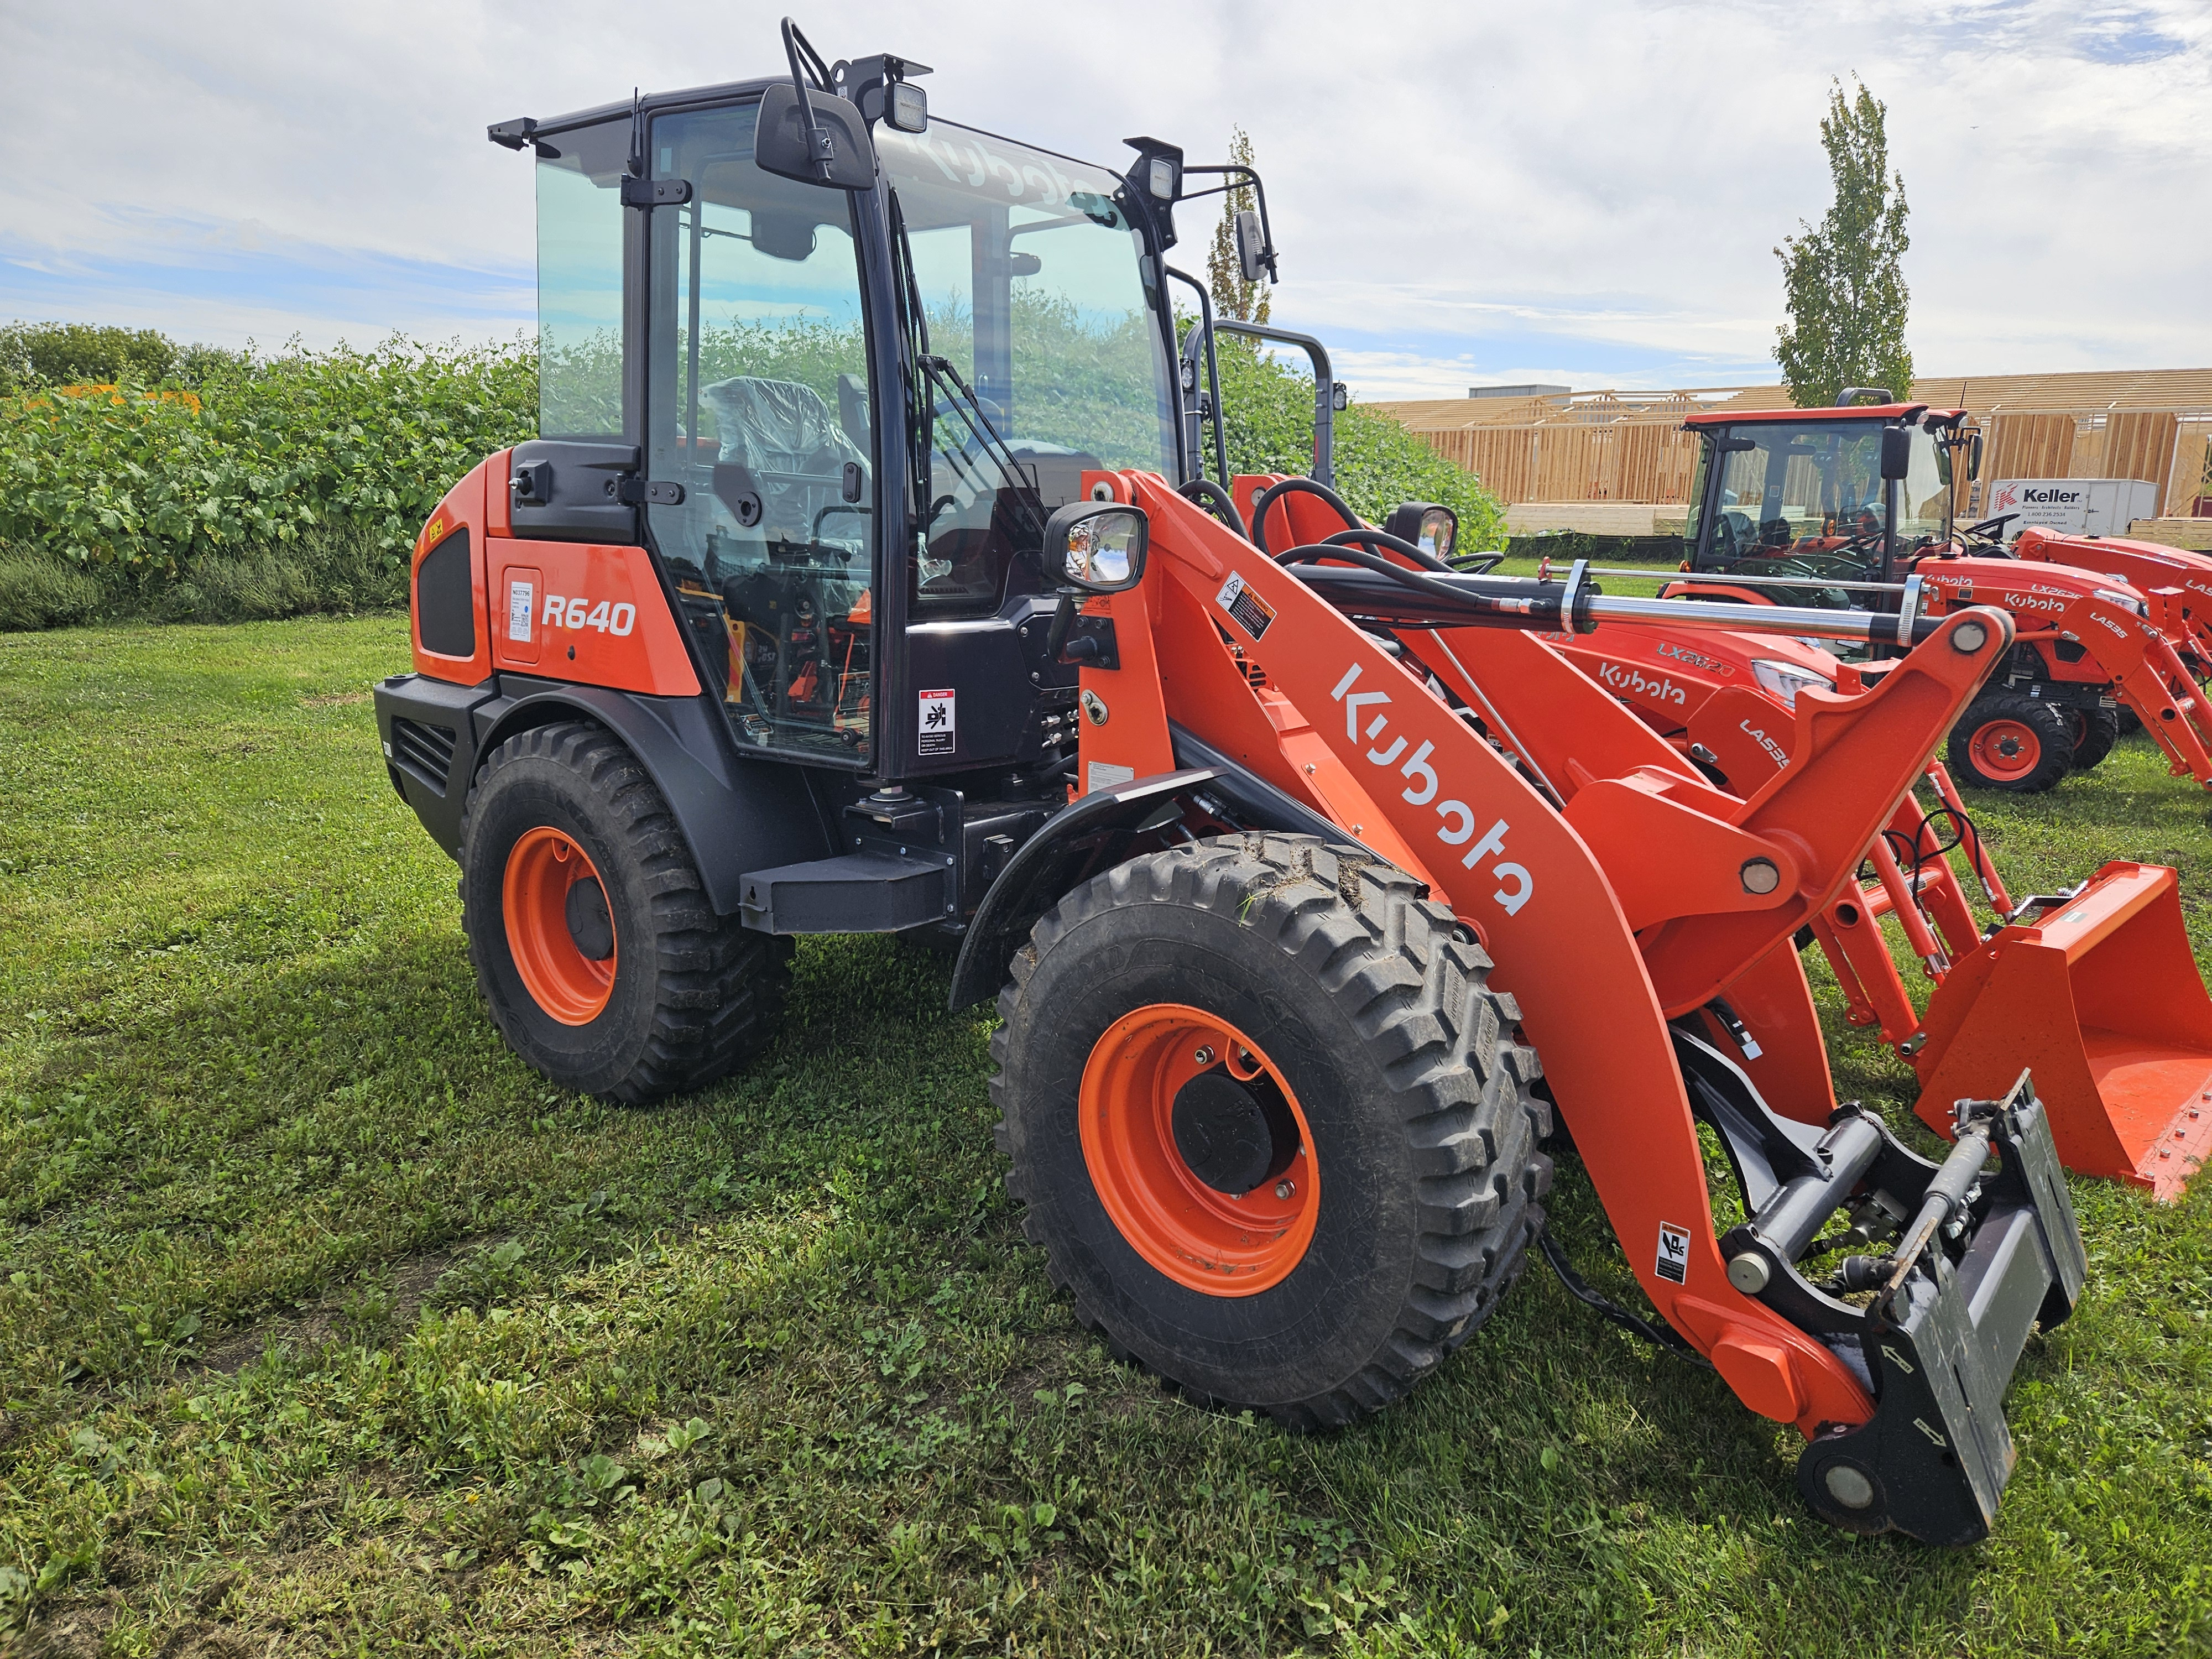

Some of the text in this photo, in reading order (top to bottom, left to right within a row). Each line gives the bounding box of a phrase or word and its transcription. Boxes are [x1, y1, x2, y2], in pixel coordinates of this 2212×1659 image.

[902, 127, 1112, 221] Kubota
[2023, 489, 2079, 503] Keller
[541, 594, 636, 636] R640
[2005, 593, 2064, 612] Kubota
[2090, 612, 2128, 639] LA535
[1657, 643, 1735, 678] LX2620
[1599, 662, 1686, 705] Kubota
[1331, 662, 1533, 917] Kubota
